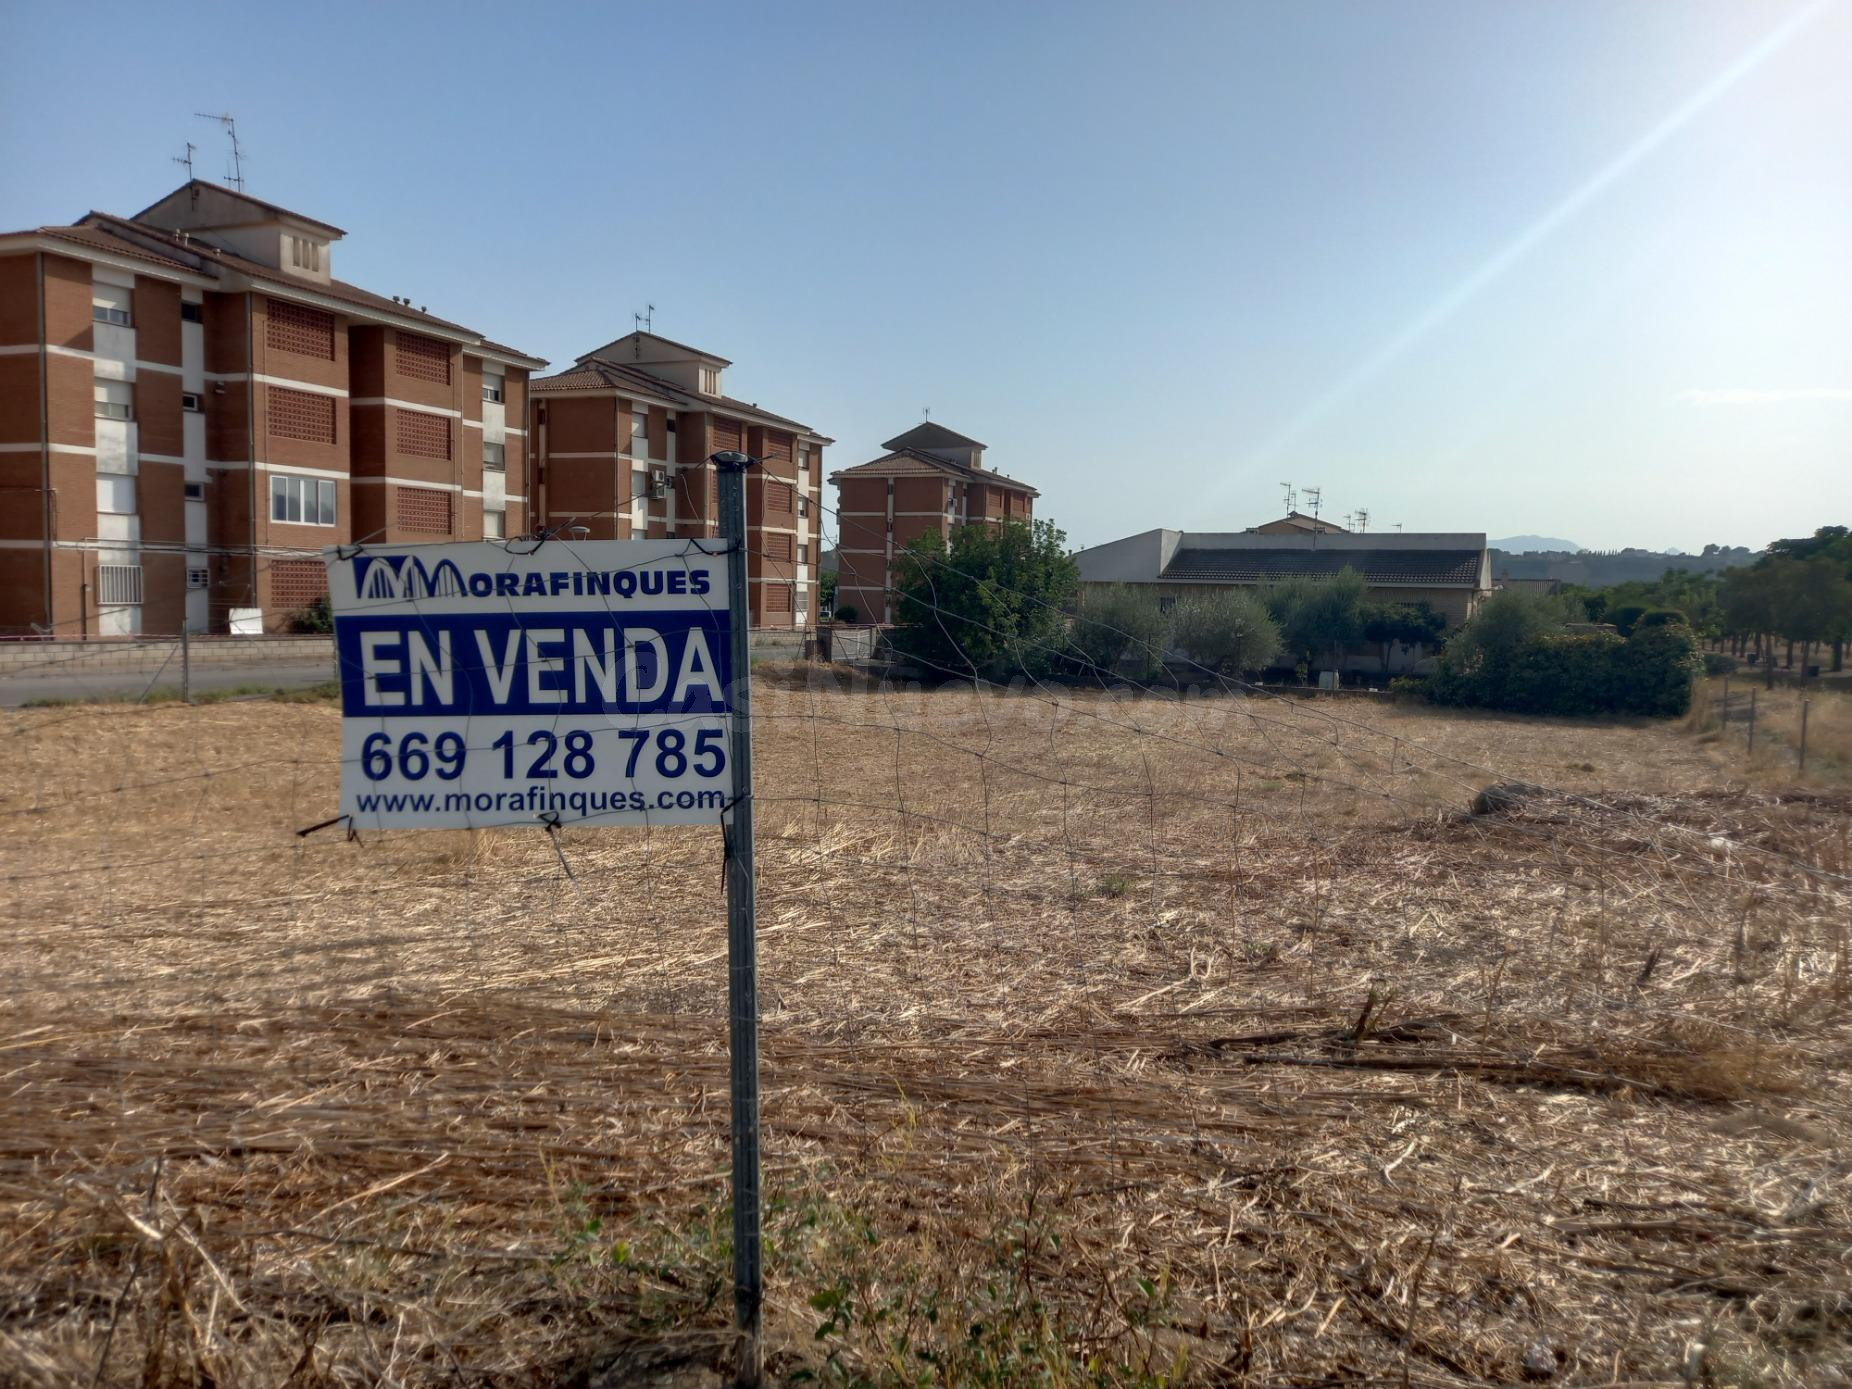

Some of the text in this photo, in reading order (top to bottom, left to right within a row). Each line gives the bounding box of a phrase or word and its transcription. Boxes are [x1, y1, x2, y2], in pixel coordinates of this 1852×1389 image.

[360, 626, 725, 706] EN VENDA
[361, 729, 726, 781] 669 128 785
[356, 785, 726, 816] www.morafinques.com
